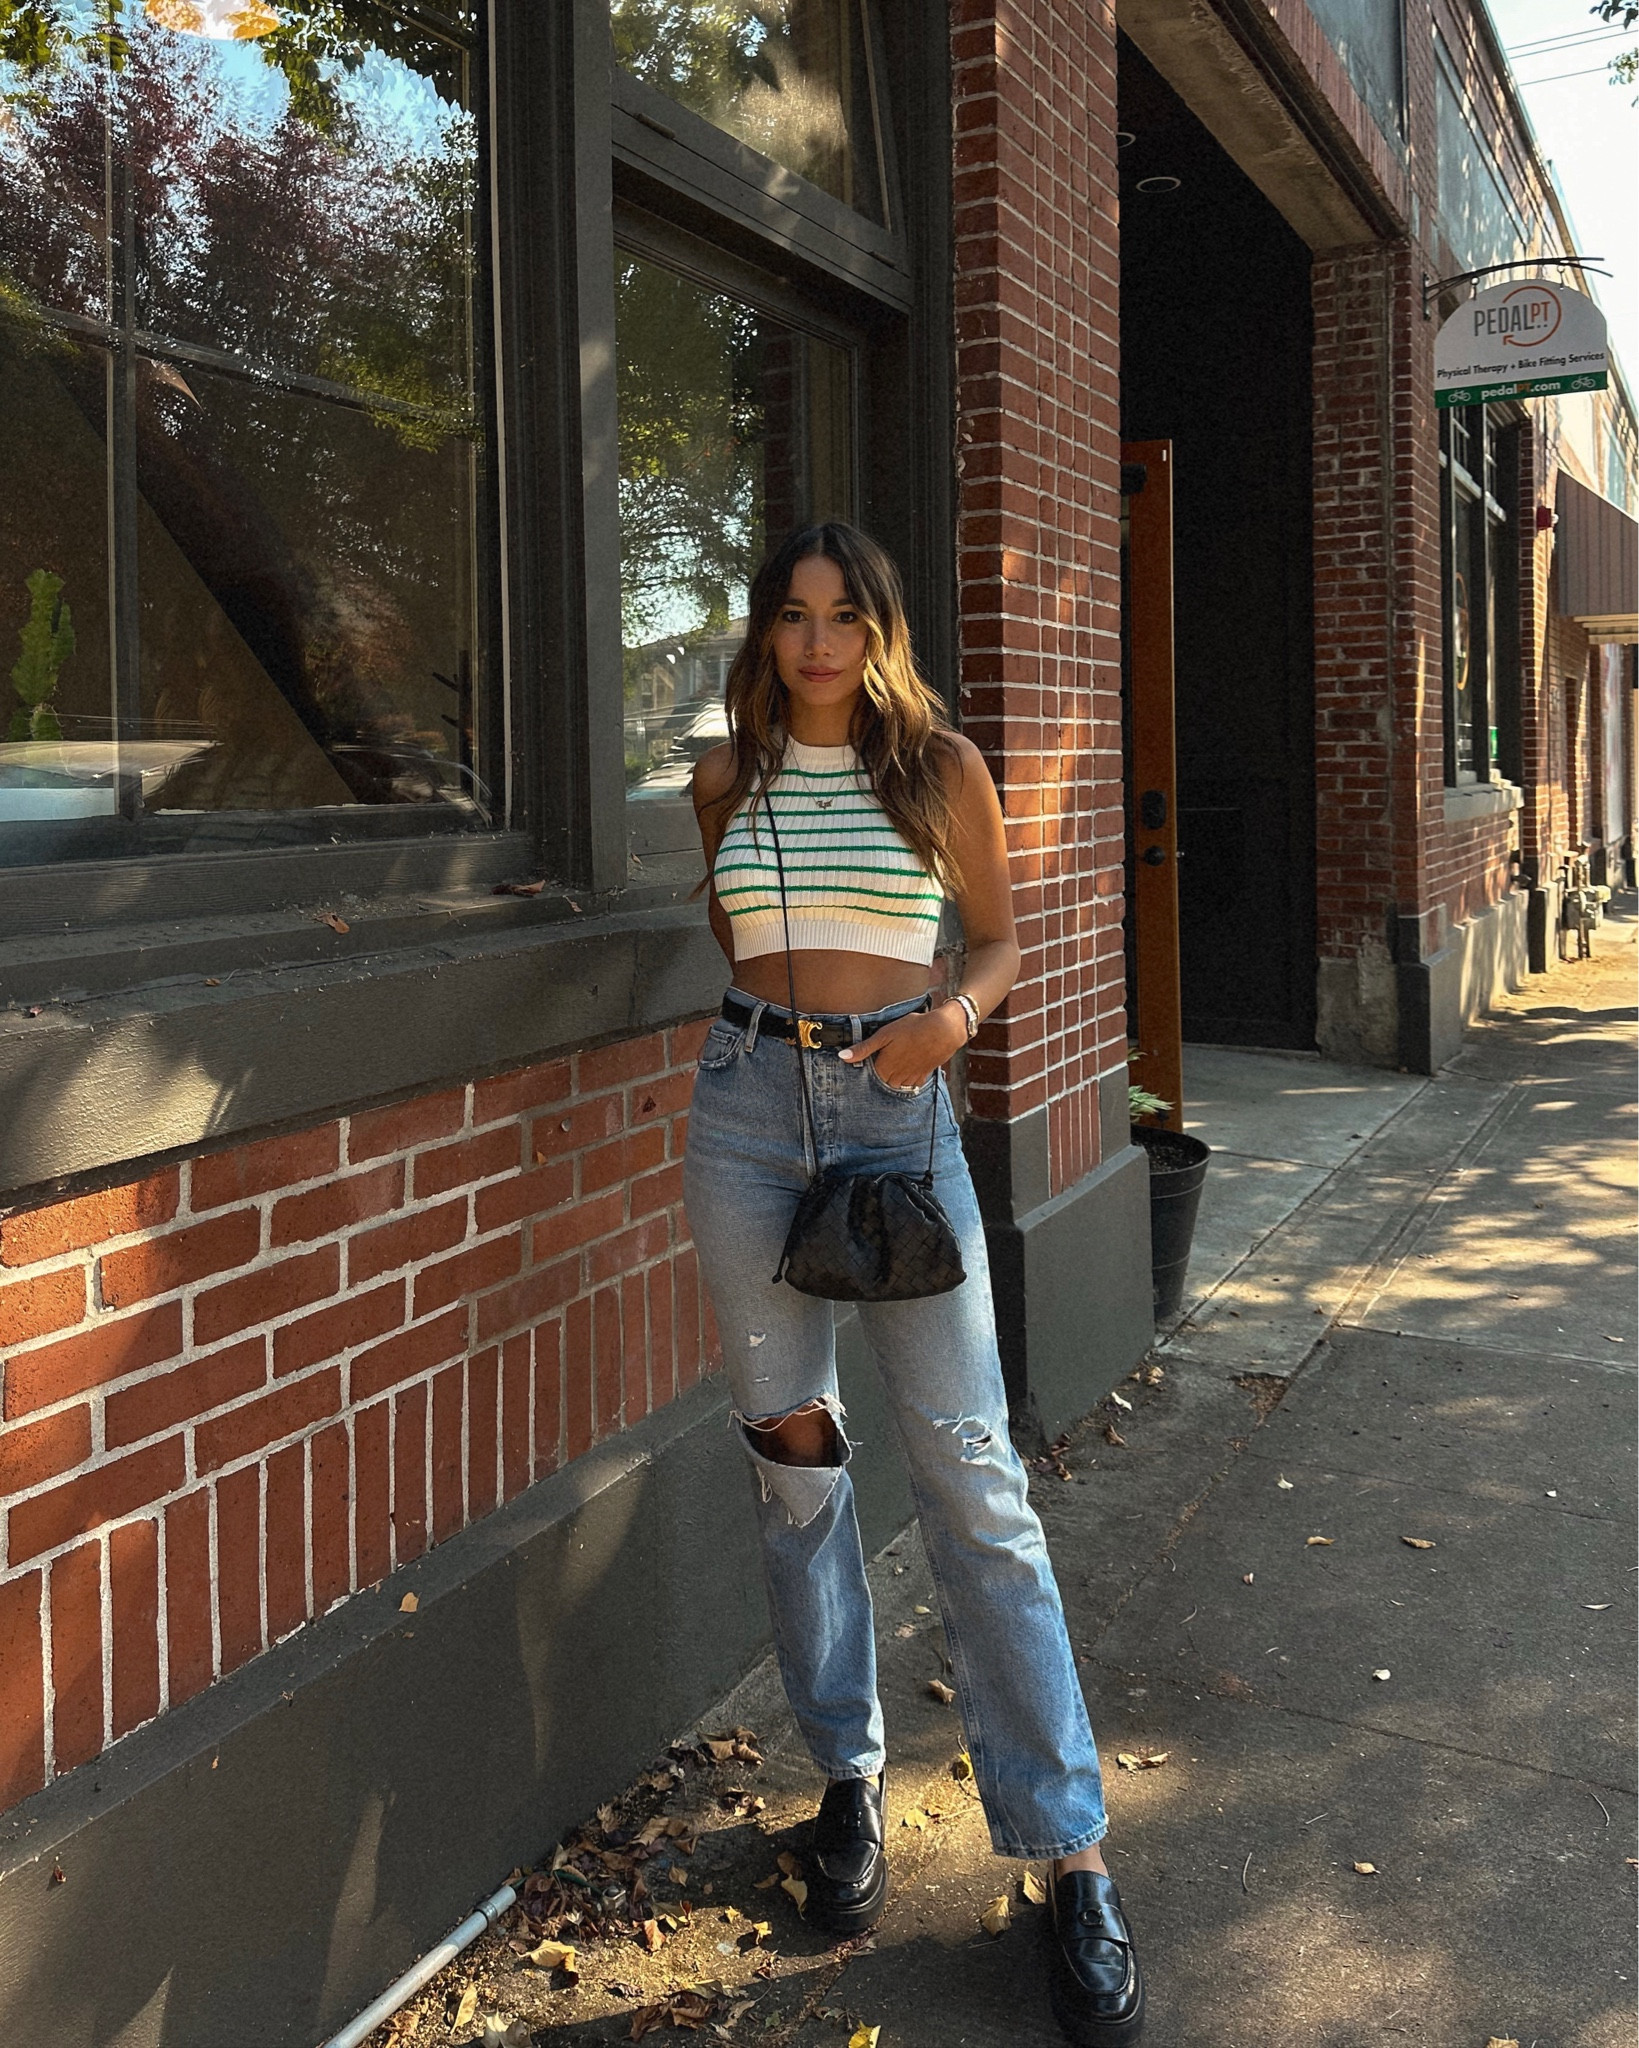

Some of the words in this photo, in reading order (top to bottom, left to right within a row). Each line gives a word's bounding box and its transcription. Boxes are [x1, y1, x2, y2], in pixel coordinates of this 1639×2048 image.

[1437, 365, 1471, 379] Physical
[1473, 364, 1508, 374] Therapy
[1518, 359, 1537, 369] Bike
[1539, 356, 1566, 367] Fitting
[1568, 352, 1604, 363] Services
[1481, 382, 1561, 400] pedalPT.com
